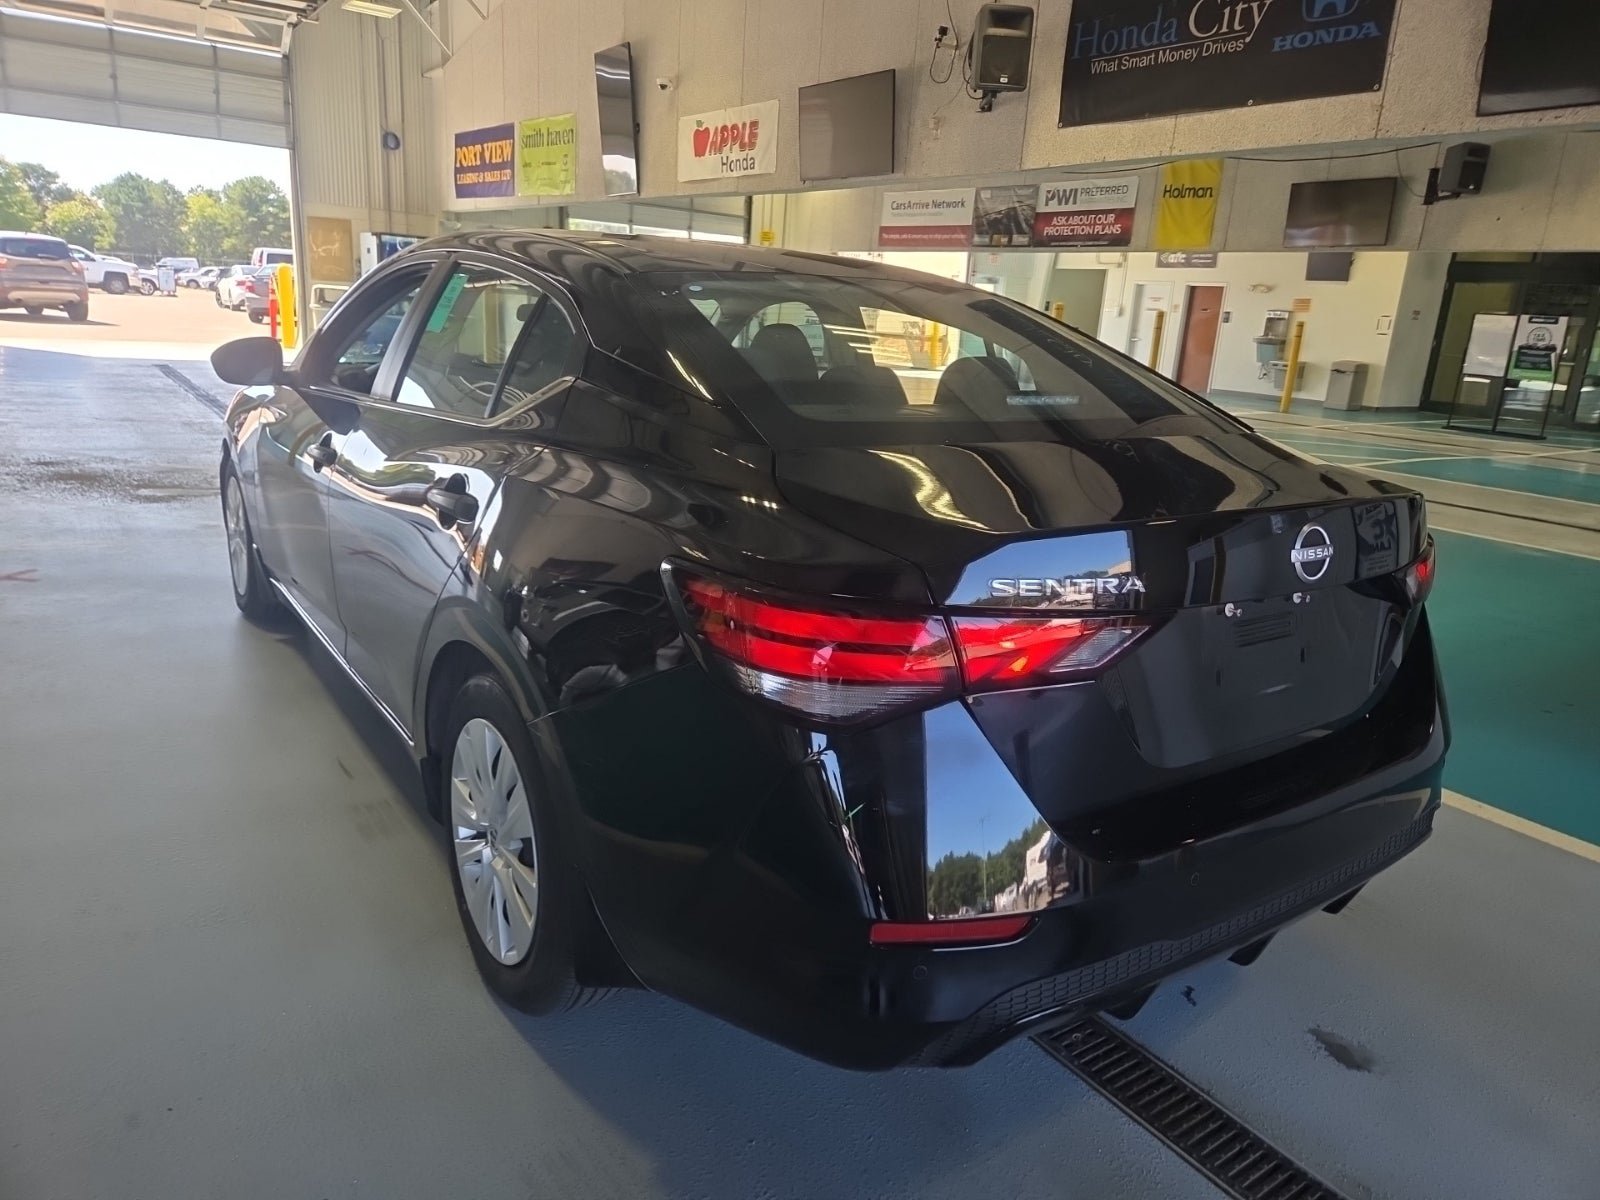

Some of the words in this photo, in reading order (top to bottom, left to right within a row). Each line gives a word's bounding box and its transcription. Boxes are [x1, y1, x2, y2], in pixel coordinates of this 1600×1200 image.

[1071, 4, 1179, 59] Honda
[1188, 0, 1272, 43] City
[1271, 21, 1382, 52] HONDA
[1091, 60, 1118, 75] What
[1121, 53, 1155, 70] Smart
[1158, 46, 1200, 64] Money
[1202, 37, 1245, 57] Drives
[521, 127, 545, 150] smith
[546, 125, 575, 147] haven
[708, 119, 760, 157] APPLE
[456, 144, 482, 168] PORT
[483, 139, 513, 164] VIEW
[721, 153, 756, 173] Honda
[1044, 186, 1079, 207] PWI
[1079, 184, 1129, 197] PREFERRED
[1162, 183, 1213, 199] Holman
[890, 199, 930, 211] CarsArrive
[931, 198, 967, 210] Network
[1043, 225, 1093, 237] PROTECTION
[1093, 224, 1122, 235] PLANS
[1051, 216, 1068, 226] ASK
[1067, 214, 1095, 225] ABOUT
[1095, 213, 1116, 224] OUR
[1293, 545, 1334, 561] NISSAN
[988, 575, 1146, 598] SENTRA
